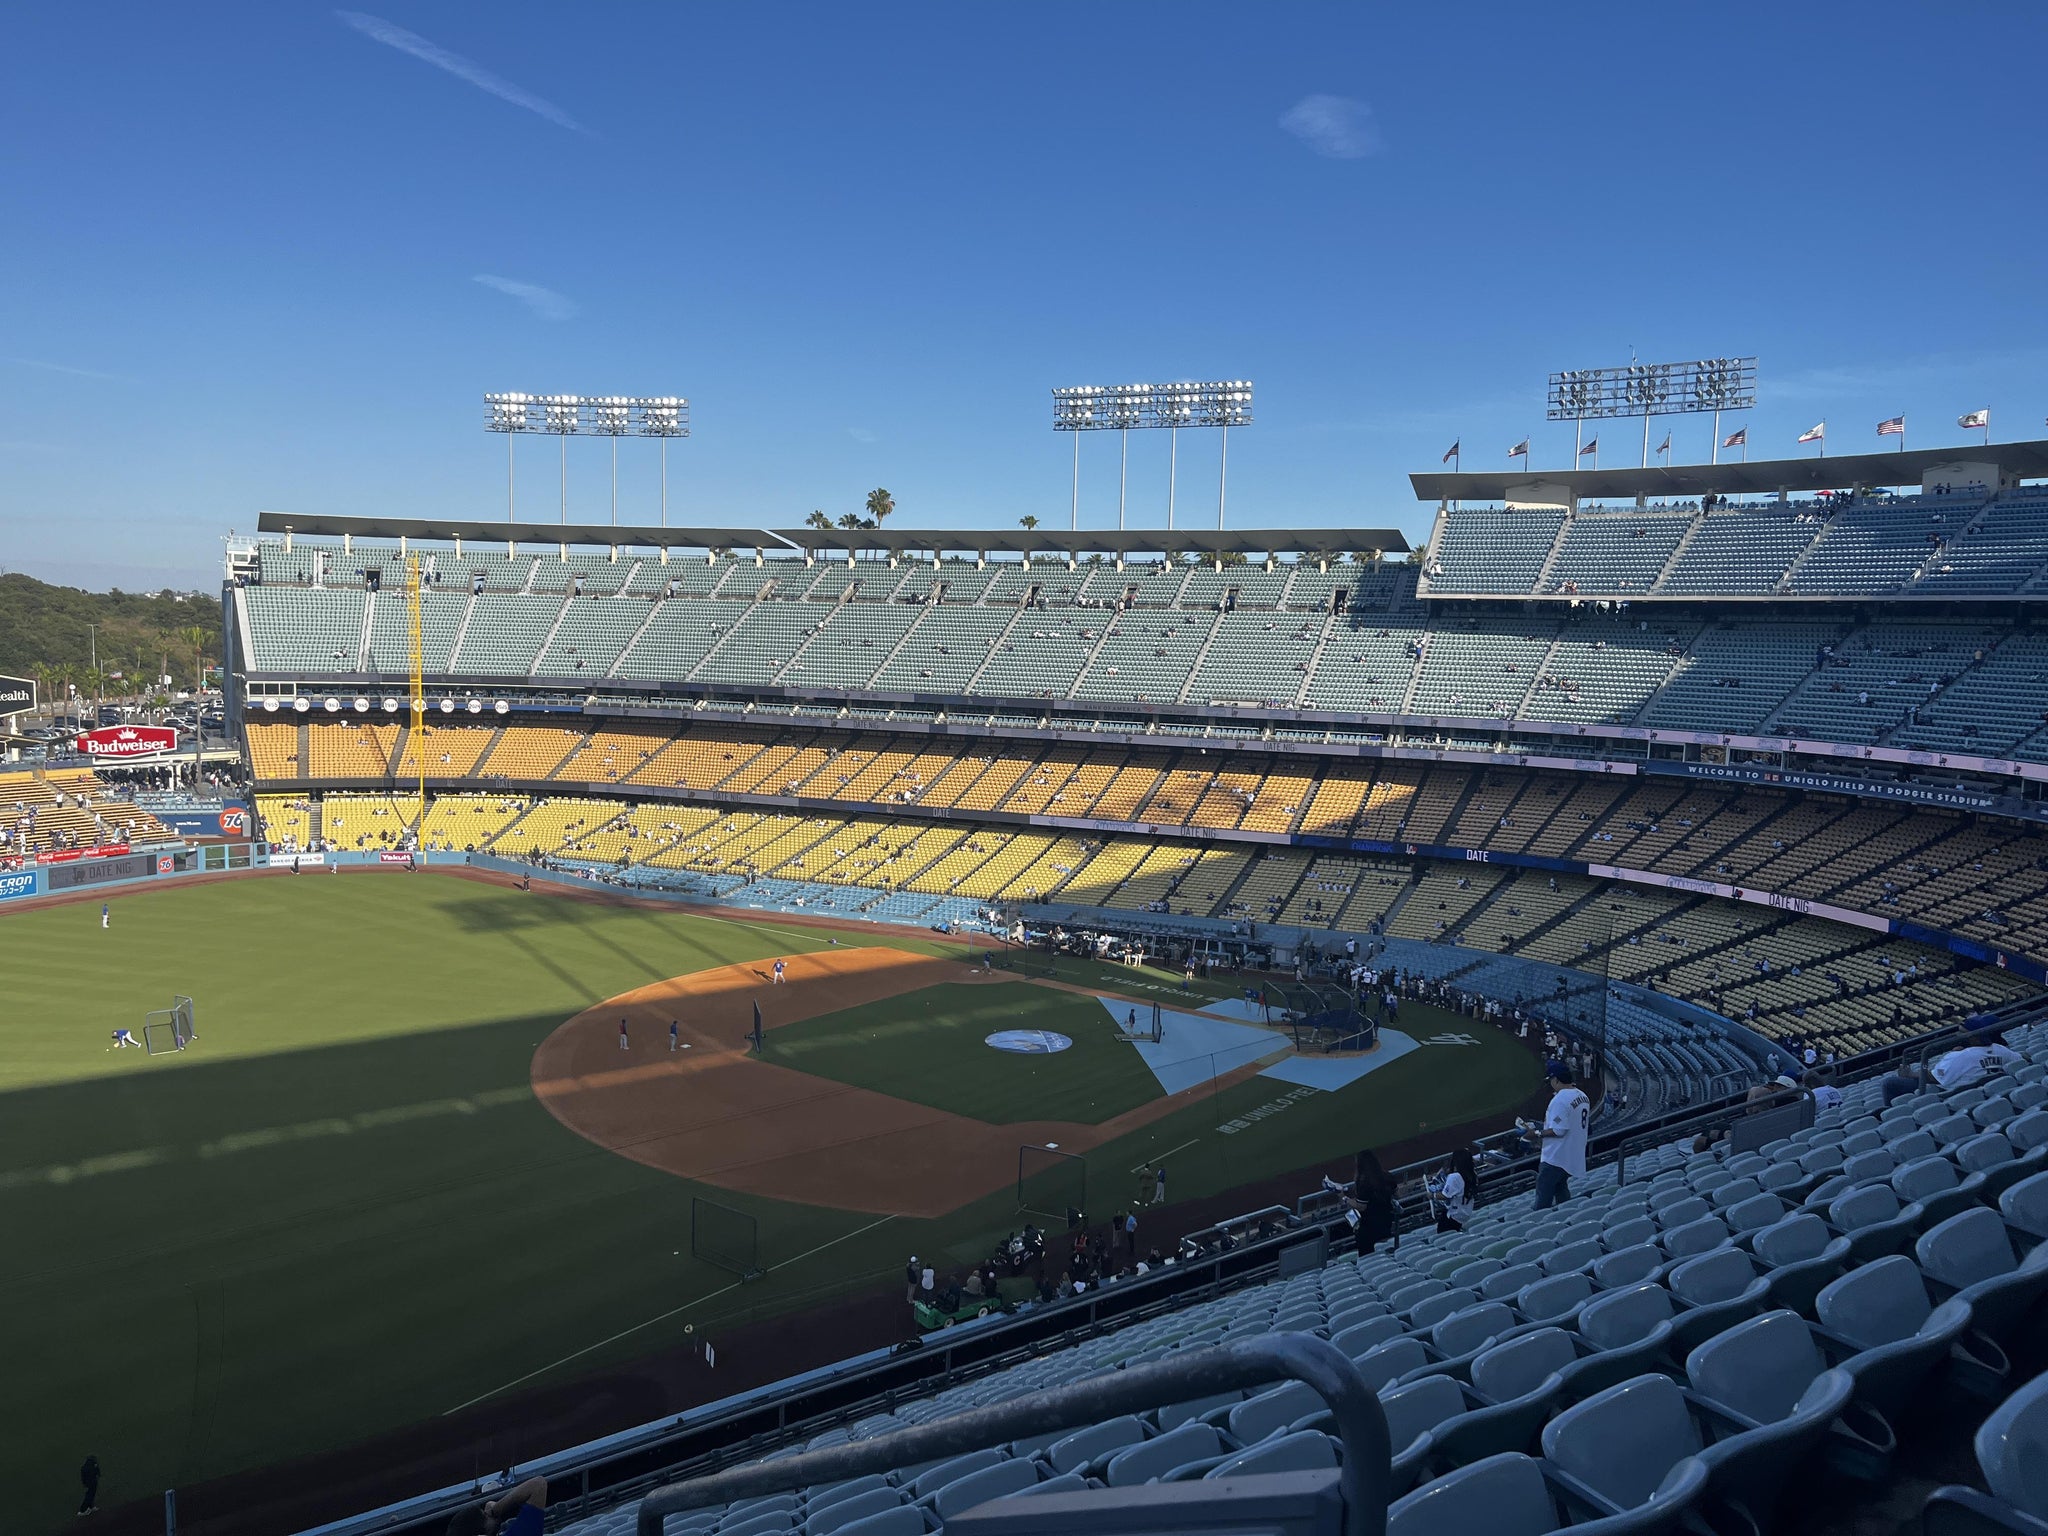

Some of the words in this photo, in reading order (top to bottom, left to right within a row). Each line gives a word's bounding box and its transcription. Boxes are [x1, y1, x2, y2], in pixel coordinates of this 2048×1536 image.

[0, 690, 30, 701] ealth
[1688, 766, 1740, 777] WELCOME
[1745, 771, 1759, 779] TO
[1784, 775, 1830, 787] UNIQLO
[1833, 780, 1865, 791] FIELD
[1869, 785, 1883, 793] AT
[1887, 787, 1934, 800] DODGER
[1936, 793, 1987, 807] STADIUM
[932, 808, 950, 817] DATE
[1180, 827, 1200, 837] DATE
[1466, 849, 1489, 863] DATE
[89, 867, 113, 879] DATE
[1768, 893, 1791, 910] DATE
[1241, 1098, 1294, 1121] UNIQLO
[1581, 1108, 1588, 1130] 8
